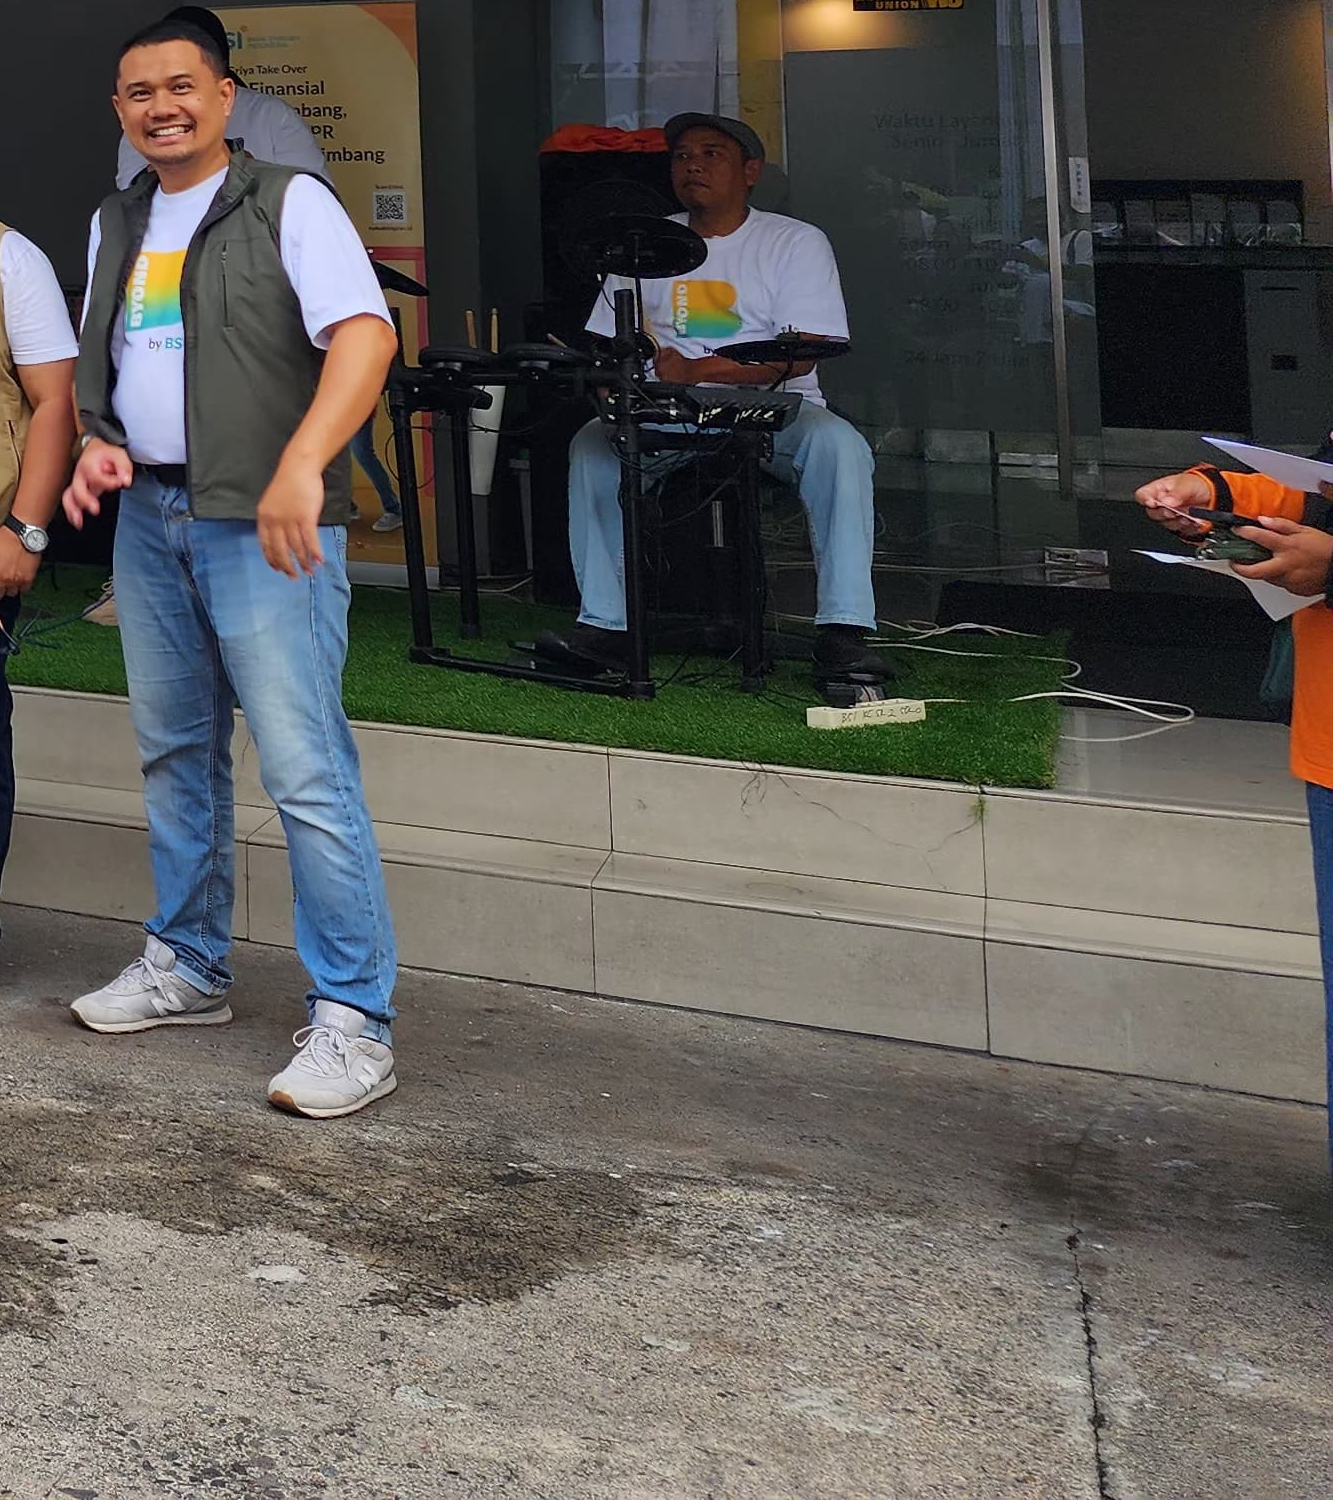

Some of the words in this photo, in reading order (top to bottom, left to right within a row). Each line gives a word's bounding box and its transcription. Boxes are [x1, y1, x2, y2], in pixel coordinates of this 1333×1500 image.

[875, 1, 919, 9] UNION
[256, 65, 280, 74] Take
[282, 64, 308, 74] Over
[249, 81, 325, 96] Finansial
[130, 255, 150, 328] BYOND
[149, 336, 162, 352] by
